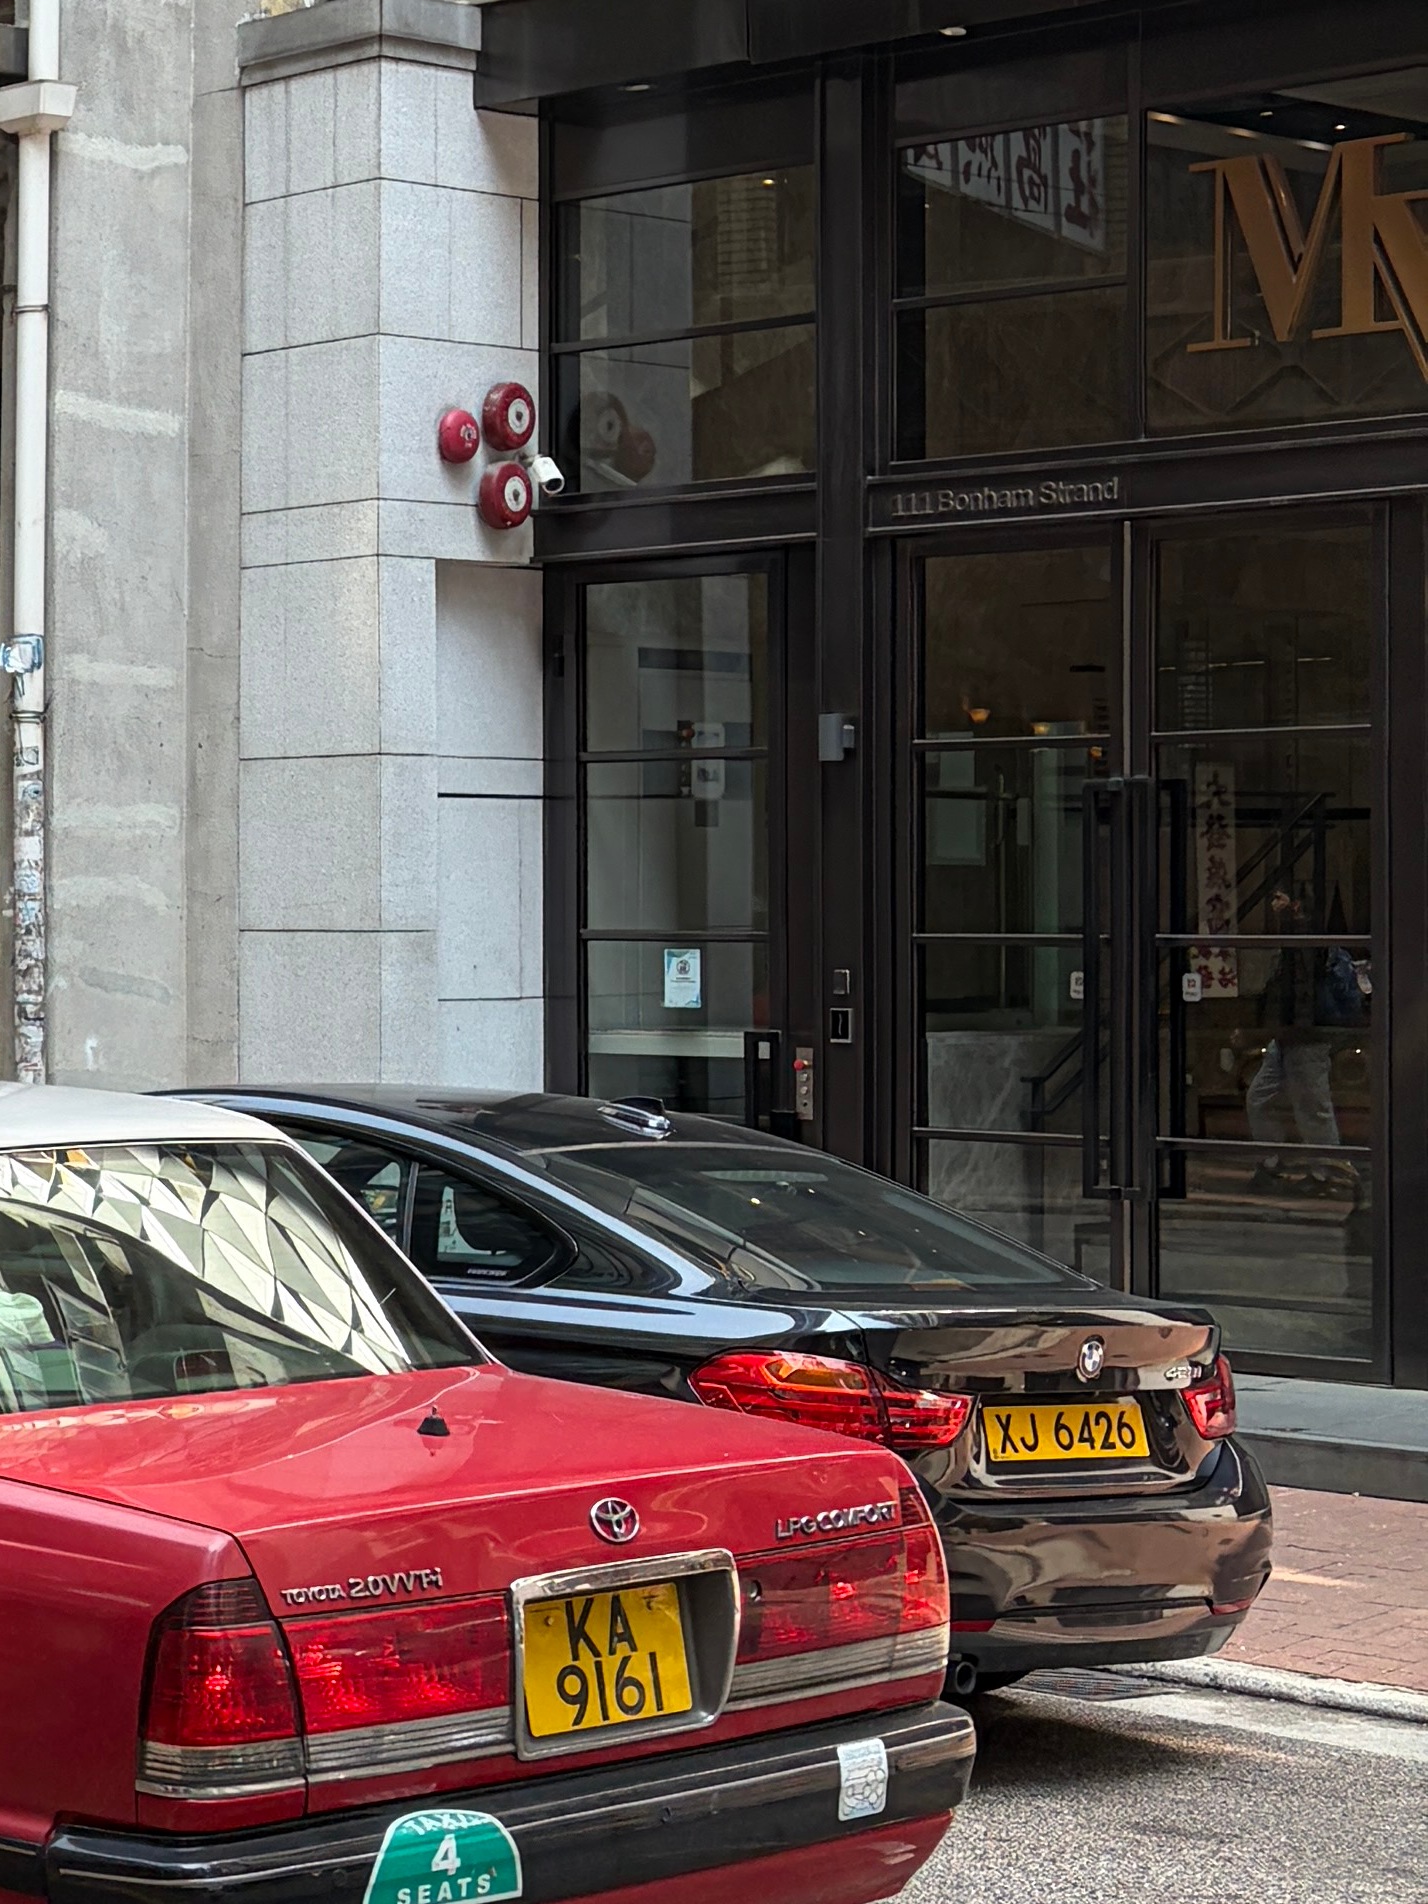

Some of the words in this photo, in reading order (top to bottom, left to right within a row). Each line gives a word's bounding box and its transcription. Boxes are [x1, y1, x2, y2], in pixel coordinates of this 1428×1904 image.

[937, 487, 1035, 512] Bonham
[1040, 477, 1120, 504] Strand
[995, 1413, 1040, 1454] XJ
[1054, 1410, 1136, 1451] 6426
[816, 1501, 897, 1530] COMFORT
[281, 1584, 346, 1605] TOYOTA
[565, 1594, 638, 1661] KA
[556, 1653, 665, 1728] 9161
[431, 1833, 461, 1876] 4
